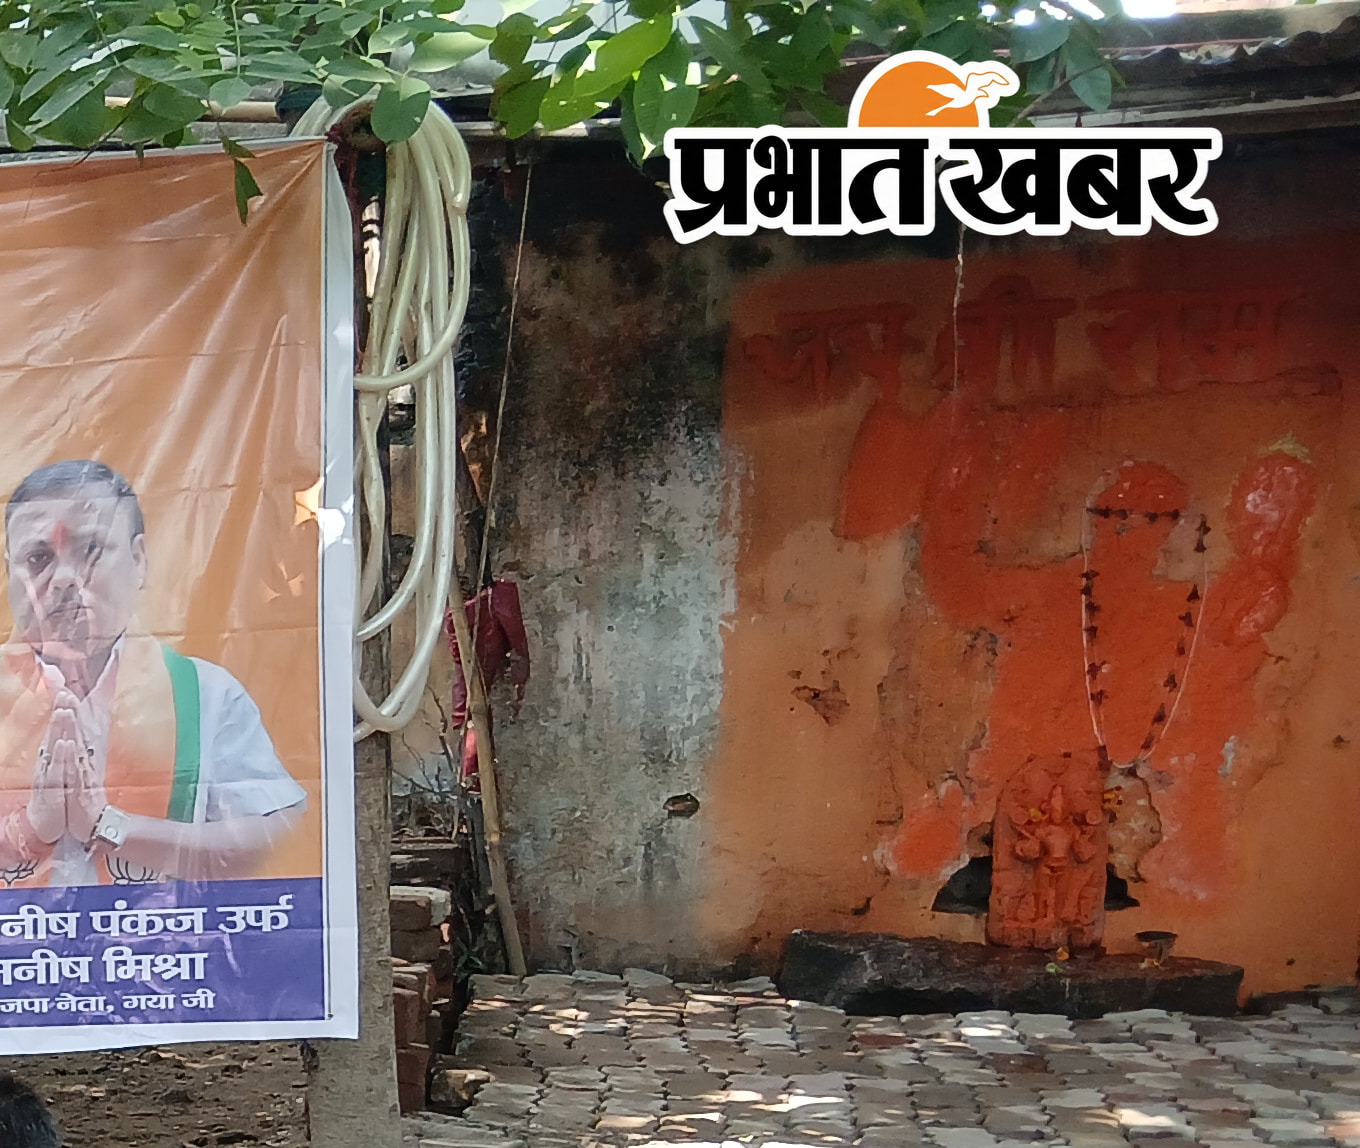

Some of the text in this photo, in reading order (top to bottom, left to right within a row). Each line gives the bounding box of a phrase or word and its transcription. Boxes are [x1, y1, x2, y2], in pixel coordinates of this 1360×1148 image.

[88, 900, 207, 938] पंकज
[216, 893, 294, 934] उर्फ
[102, 944, 208, 984] मिश्रा
[55, 992, 115, 1014] नेता,
[122, 993, 175, 1011] गया
[181, 988, 216, 1010] जी
